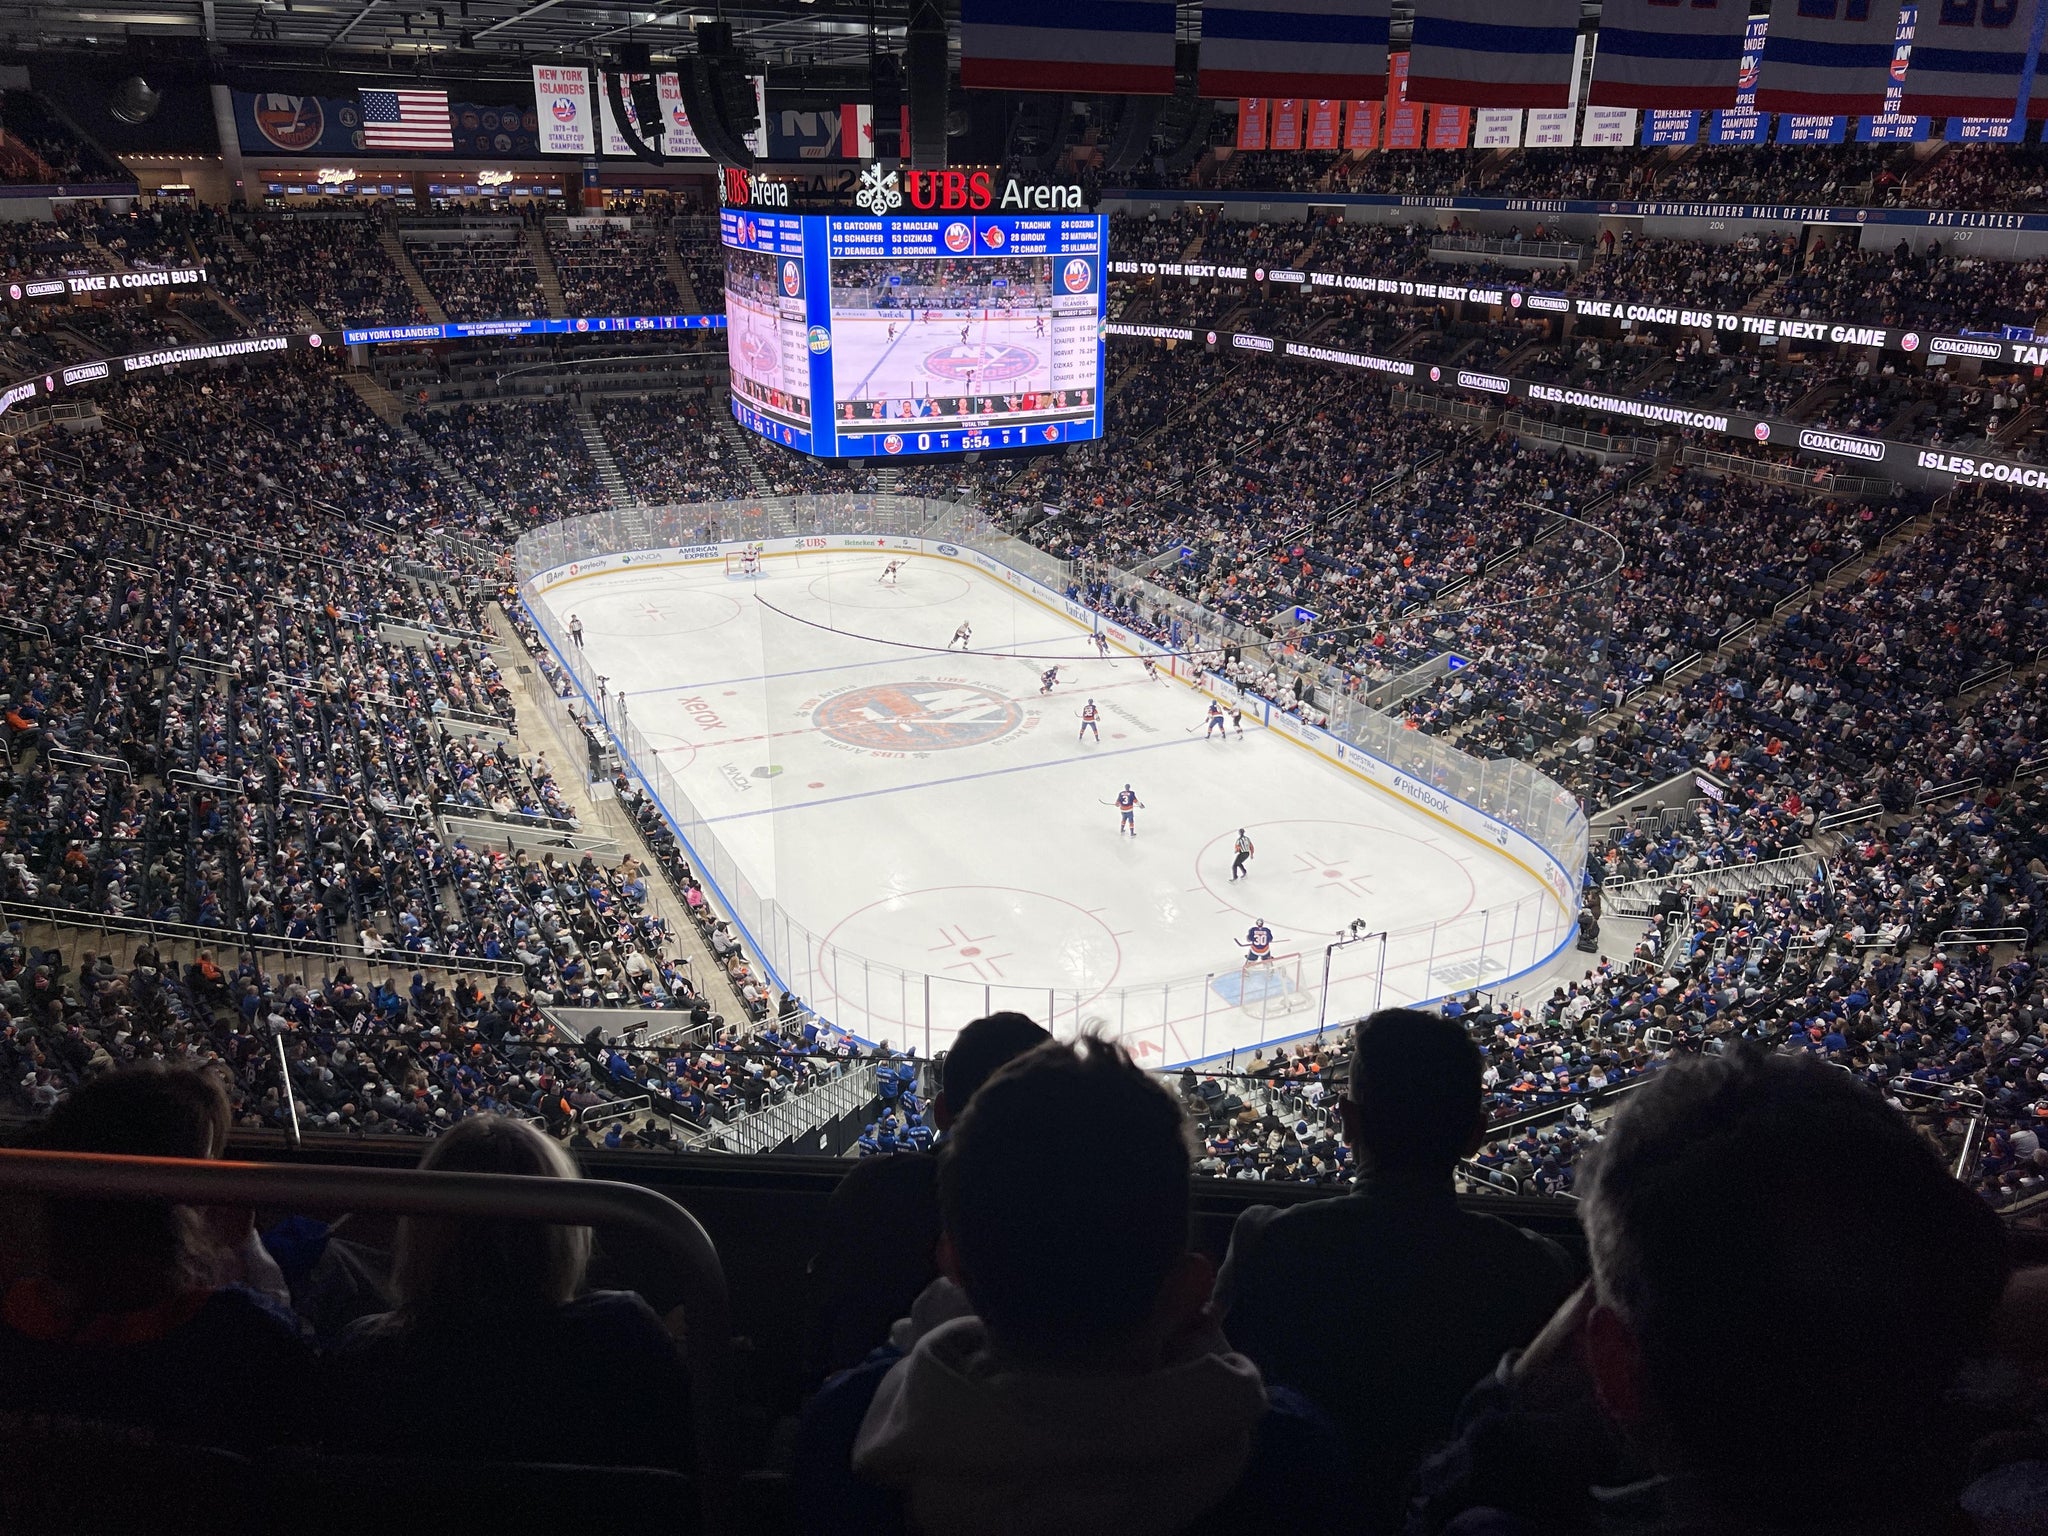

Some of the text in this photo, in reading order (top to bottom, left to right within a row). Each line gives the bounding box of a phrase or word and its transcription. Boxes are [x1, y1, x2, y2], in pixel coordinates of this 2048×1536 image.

[538, 69, 583, 82] NEW YORK
[661, 75, 679, 86] NEW
[540, 83, 585, 95] ISLANDERS
[1654, 120, 1689, 130] CHAMPIONS
[1722, 118, 1758, 129] CHAMPIONS
[1791, 117, 1834, 128] CHAMPIONS
[1792, 129, 1829, 140] 1980-1981
[1872, 126, 1913, 138] 1981-1982
[1962, 126, 2009, 137] 1982-1983
[571, 134, 584, 142] CUP
[551, 142, 584, 150] CHAMPIONS
[317, 168, 356, 185] Tailgate
[478, 170, 514, 187] Tailgate
[726, 168, 749, 205] UBS
[751, 175, 788, 207] Arena
[908, 171, 1082, 211] UBS Arena
[1506, 200, 1567, 212] JOHN TONELLI
[1638, 204, 1830, 221] NEW YORK ISLANDERS HALL OF FAME
[892, 222, 938, 230] 32 MACLEAN
[1070, 220, 1094, 228] COZENS
[1710, 222, 1725, 230] 206
[1928, 212, 2025, 229] PAT FLATLEY
[845, 235, 884, 243] SCHAEFER
[892, 235, 933, 243] 53 CIZIKAS
[1021, 233, 1045, 241] GIROUX
[1953, 232, 1973, 241] 207
[833, 247, 884, 255] 77 DEANGELO
[892, 246, 937, 255] 30 SOROKIN
[1021, 245, 1046, 253] CHABOT
[1061, 244, 1097, 252] 35 ULLMARK
[1116, 262, 1138, 273] BUS
[1140, 263, 1155, 274] TO
[1158, 264, 1182, 275] THE
[1184, 266, 1216, 277] NEXT
[1218, 267, 1247, 280] GAME
[68, 271, 198, 292] TAKE A COACH BUS
[1271, 272, 1304, 282] COACHMAN
[28, 284, 63, 295] COACHMAN
[1310, 273, 1502, 305] TAKE A COACH BUS TO THE NEXT GAME
[1530, 299, 1567, 310] COACHMAN
[599, 320, 606, 330] 0
[618, 322, 624, 330] 11
[635, 321, 654, 329] 5:54
[683, 318, 688, 327] 1
[1576, 300, 1886, 347] TAKE A COACH BUS TO THE NEXT GAME
[349, 328, 440, 342] NEW YORK ISLANDERS
[1235, 336, 1272, 350] COACHMAN
[1934, 340, 1998, 357] COACHMAN
[124, 338, 288, 371] ISLES.COACHMANLUXURY.COM
[1286, 343, 1414, 376] ISLES.COACHMANLUXURY.COM
[65, 366, 106, 385] COACHMAN
[1460, 374, 1507, 392] COACHMAN
[1529, 385, 1728, 432] ISLES.COACHMANLUXURY.COM
[1019, 428, 1027, 443] 1
[918, 434, 930, 450] 0
[941, 440, 949, 448] 11
[962, 436, 990, 448] 5:54
[1803, 433, 1880, 458] COACHMAN
[806, 538, 827, 548] UBS
[679, 546, 718, 555] AMERICAN
[684, 552, 719, 560] EXPRESS
[580, 560, 607, 572] paylocity
[554, 570, 564, 581] App
[1106, 625, 1126, 642] verizon
[679, 697, 728, 732] xerox
[1349, 751, 1376, 770] HOFSTRA
[1122, 796, 1129, 805] 3
[1401, 780, 1450, 814] PitchBook
[1254, 934, 1267, 946] 30
